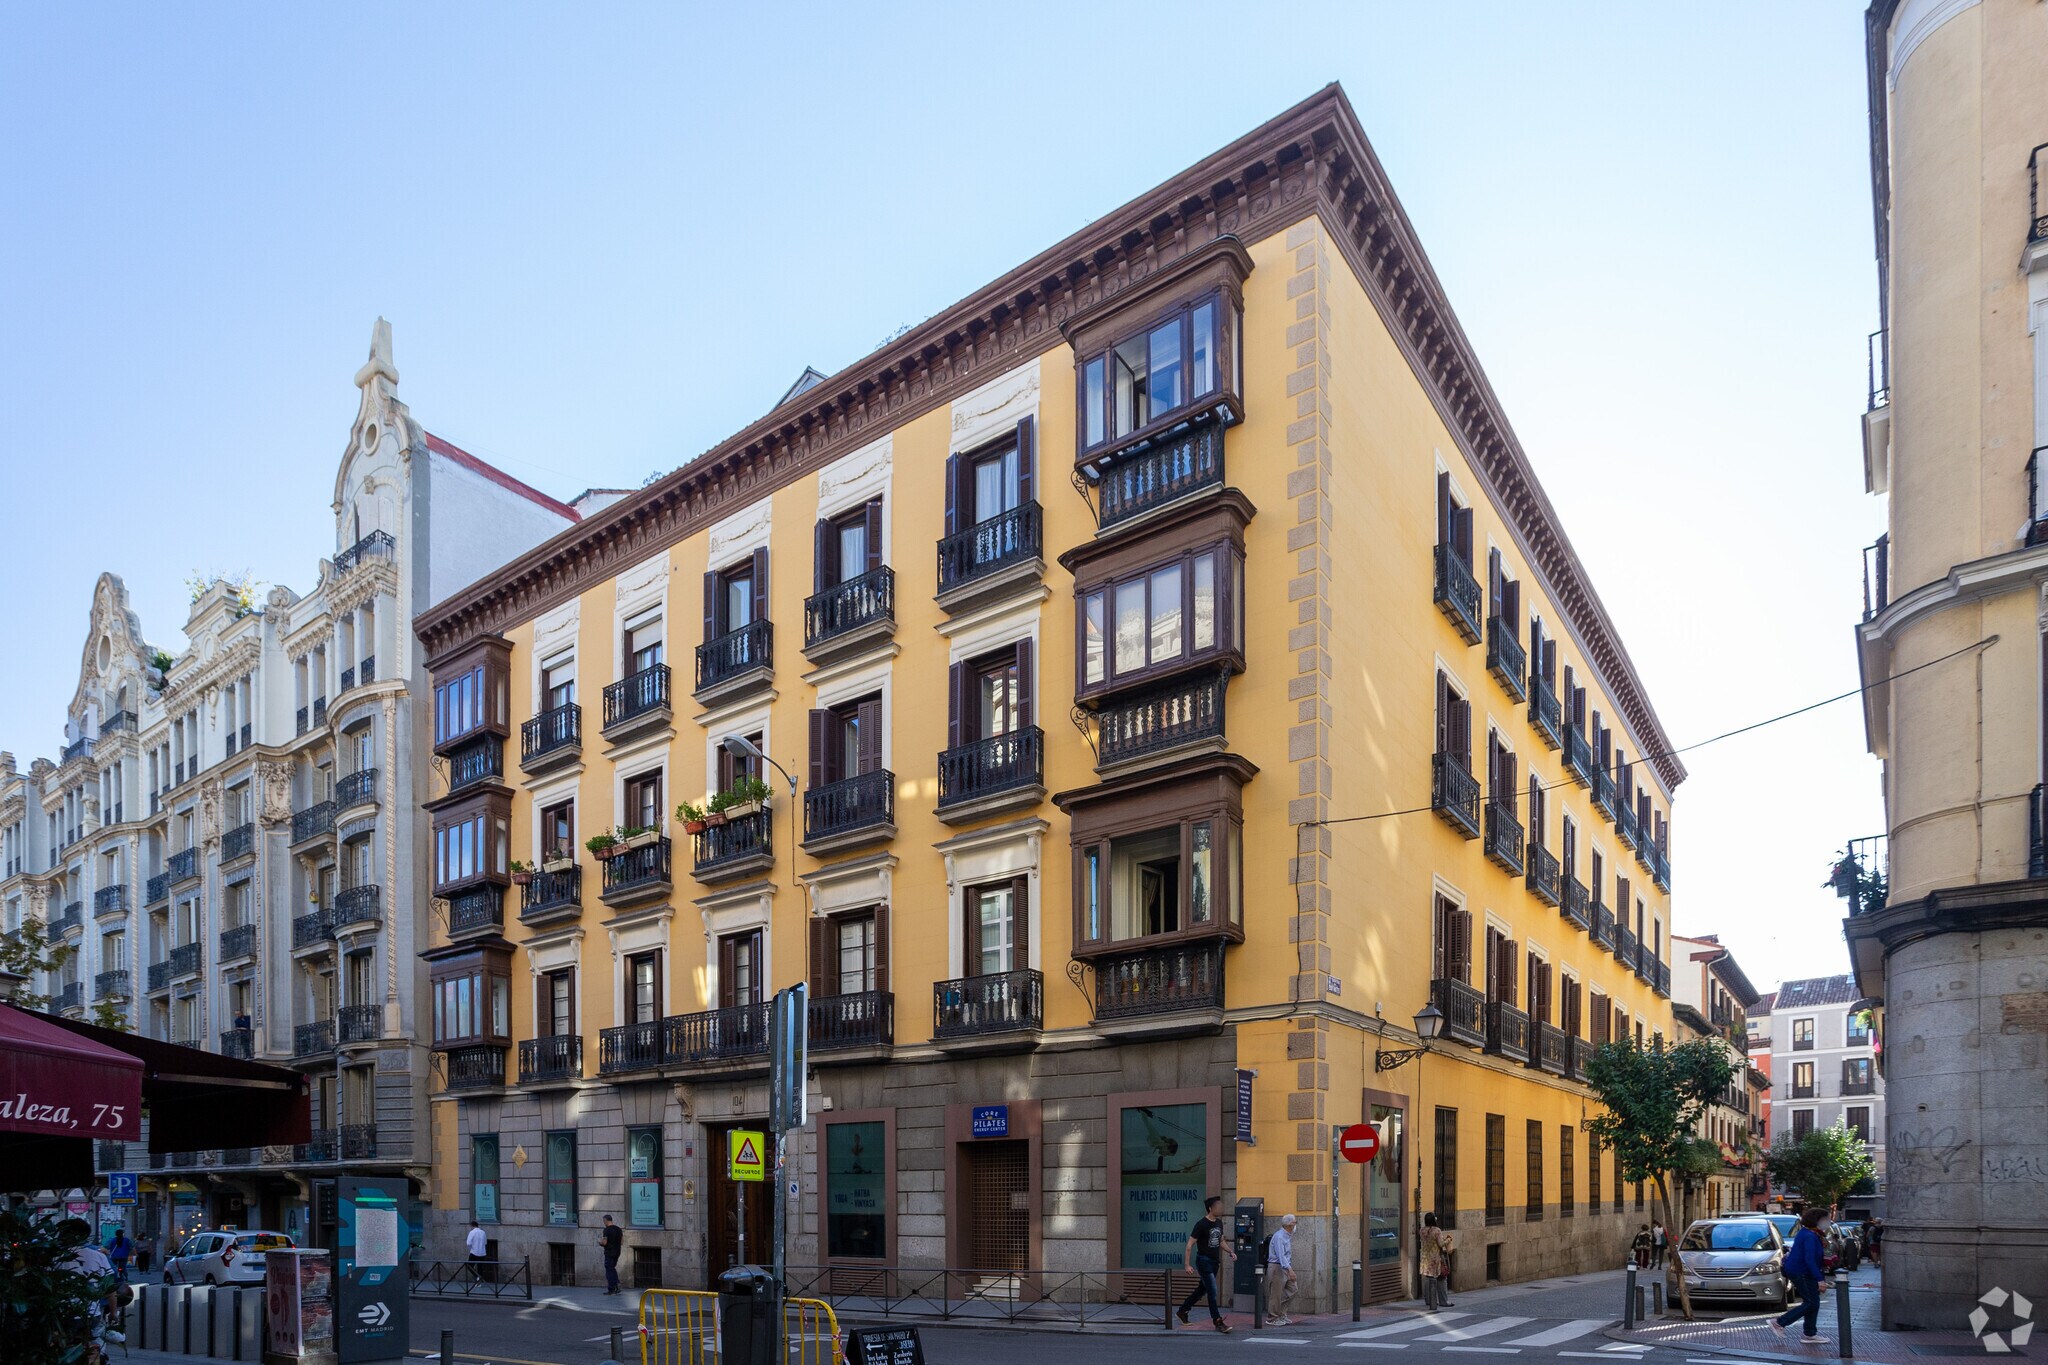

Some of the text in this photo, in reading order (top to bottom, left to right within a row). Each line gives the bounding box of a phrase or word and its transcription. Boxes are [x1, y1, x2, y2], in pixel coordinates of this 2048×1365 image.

[91, 1103, 125, 1129] 75
[115, 1177, 131, 1194] P
[834, 1193, 848, 1203] YOGA
[1130, 1187, 1198, 1201] PILATES MÁQUINAS
[1139, 1210, 1188, 1222] MATT PILATES
[1139, 1231, 1187, 1243] FISIOTERAPIA
[1144, 1251, 1182, 1264] NUTRICIÓN
